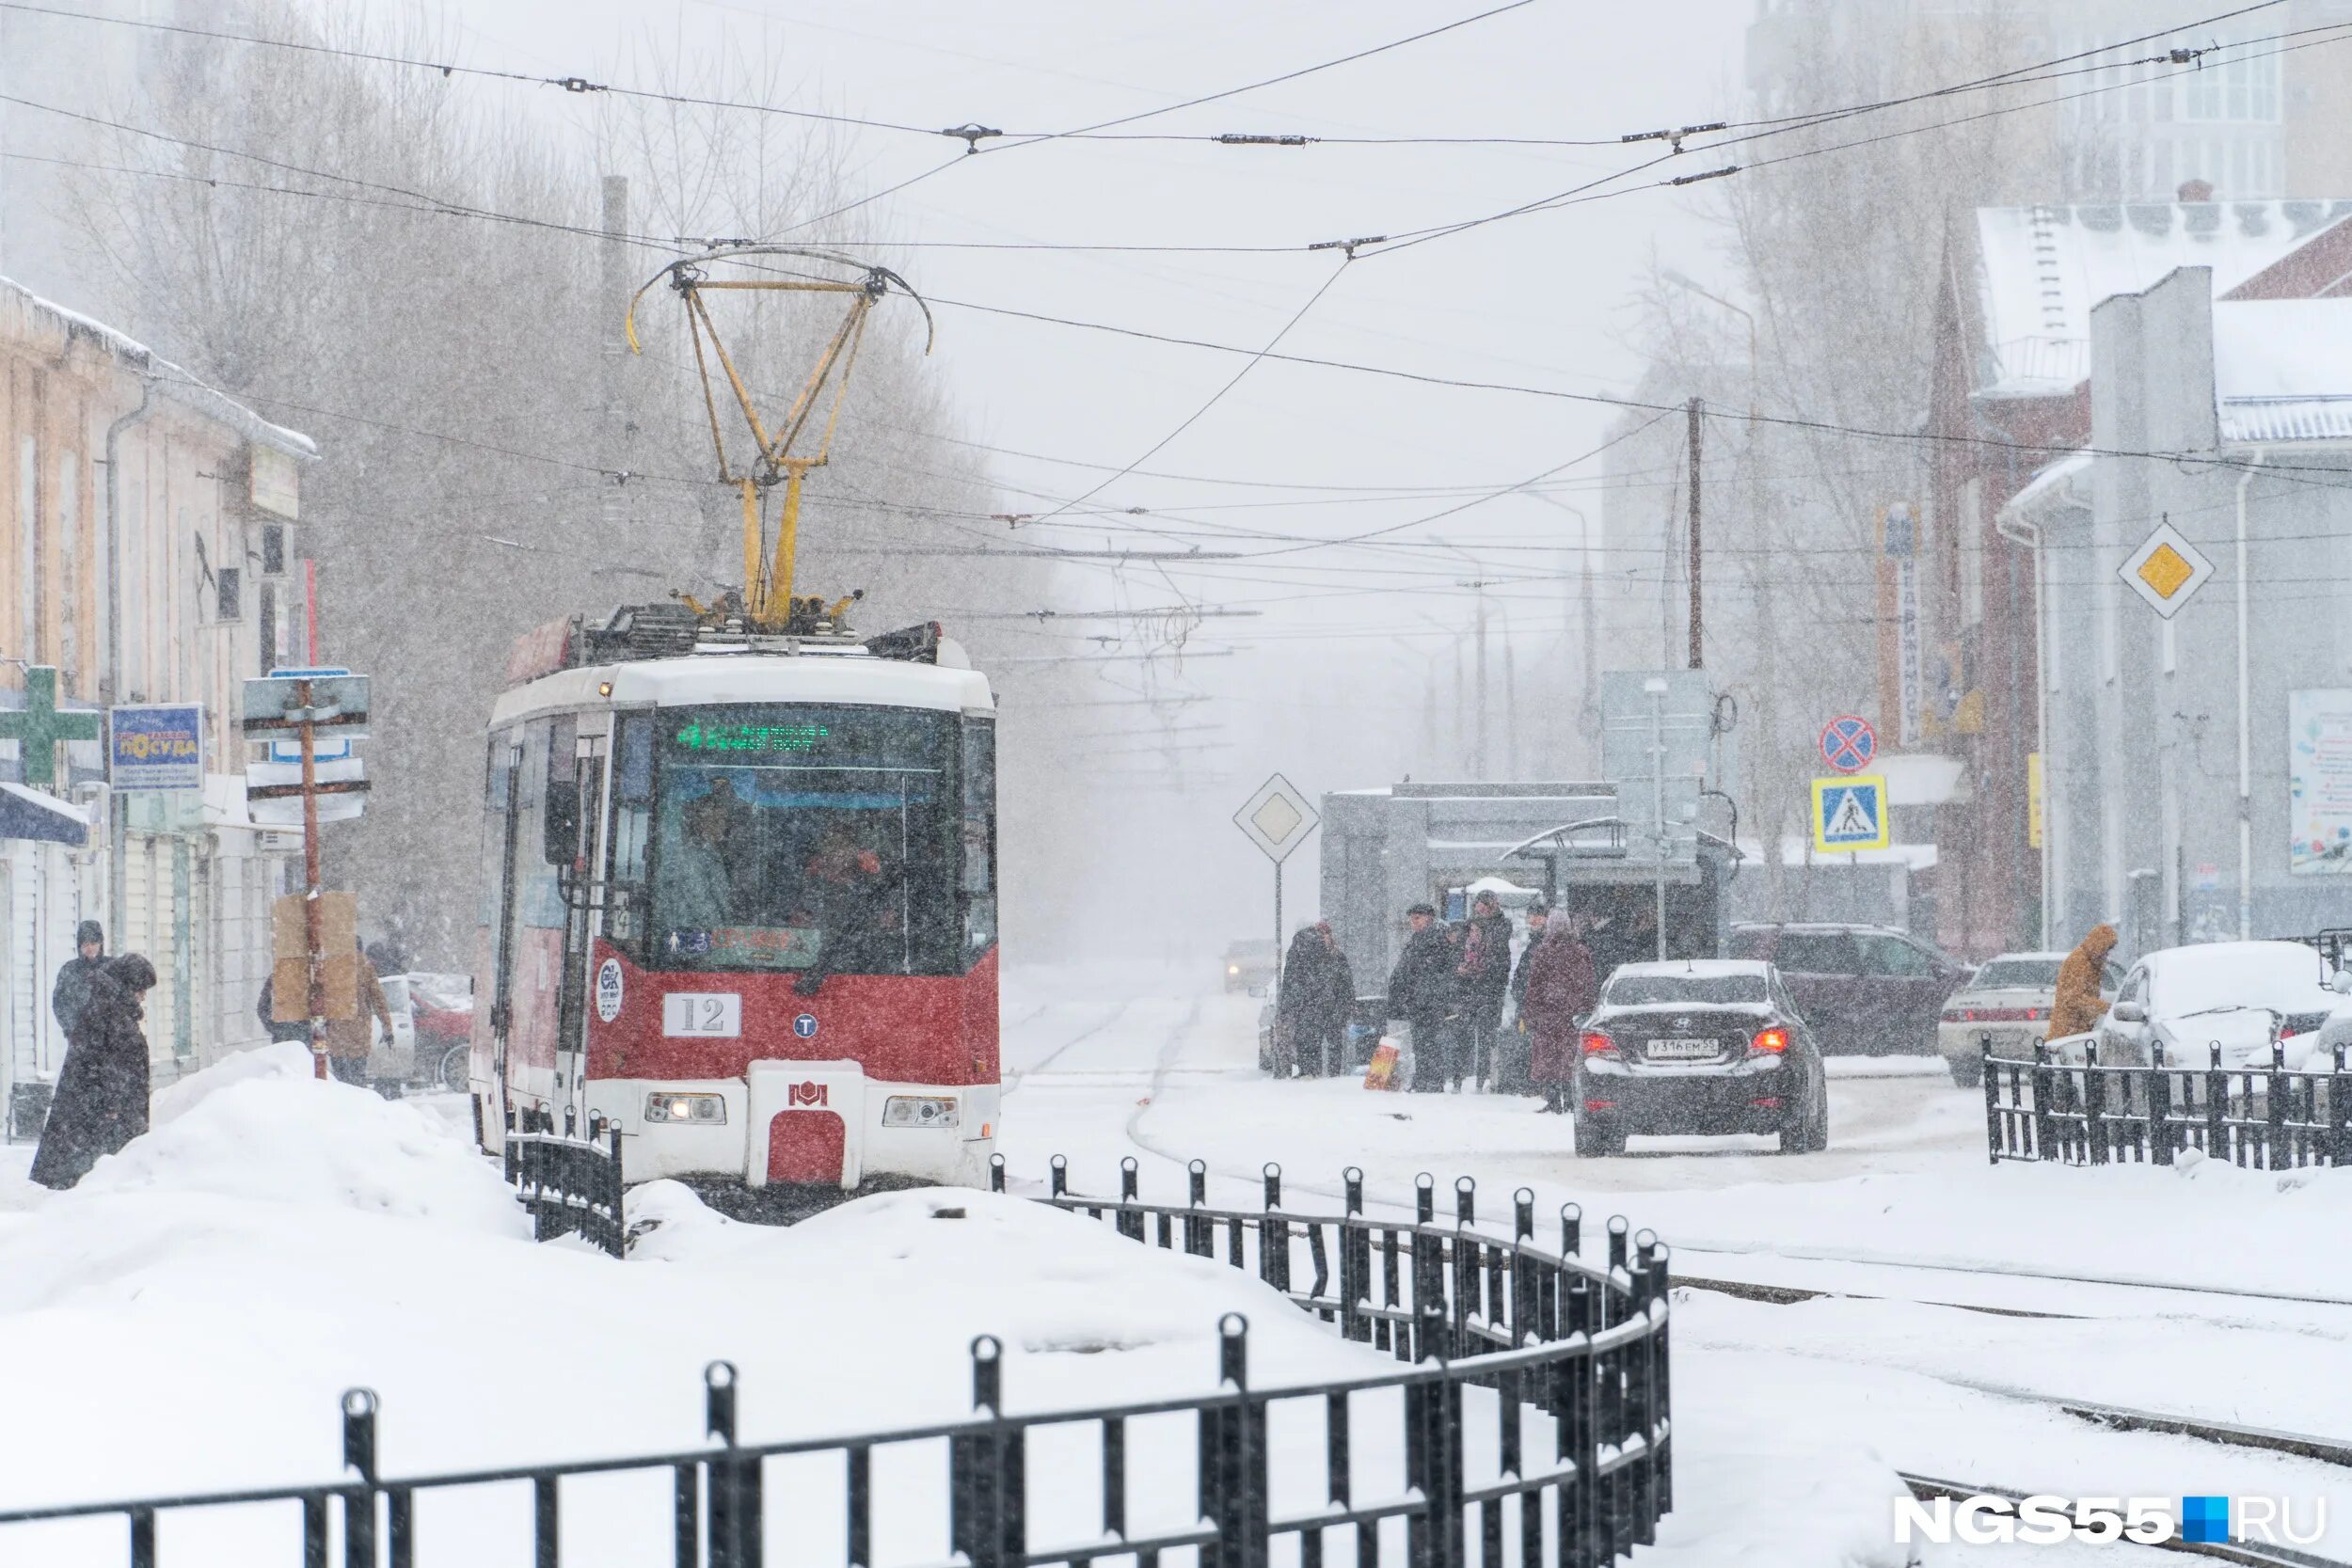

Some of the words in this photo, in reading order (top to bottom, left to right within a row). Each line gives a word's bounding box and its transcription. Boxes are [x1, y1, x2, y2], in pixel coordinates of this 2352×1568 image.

[1902, 561, 1918, 743] НЕДВИЖИМОСТЬ
[119, 734, 197, 759] ПОСУДА
[682, 998, 723, 1031] 12
